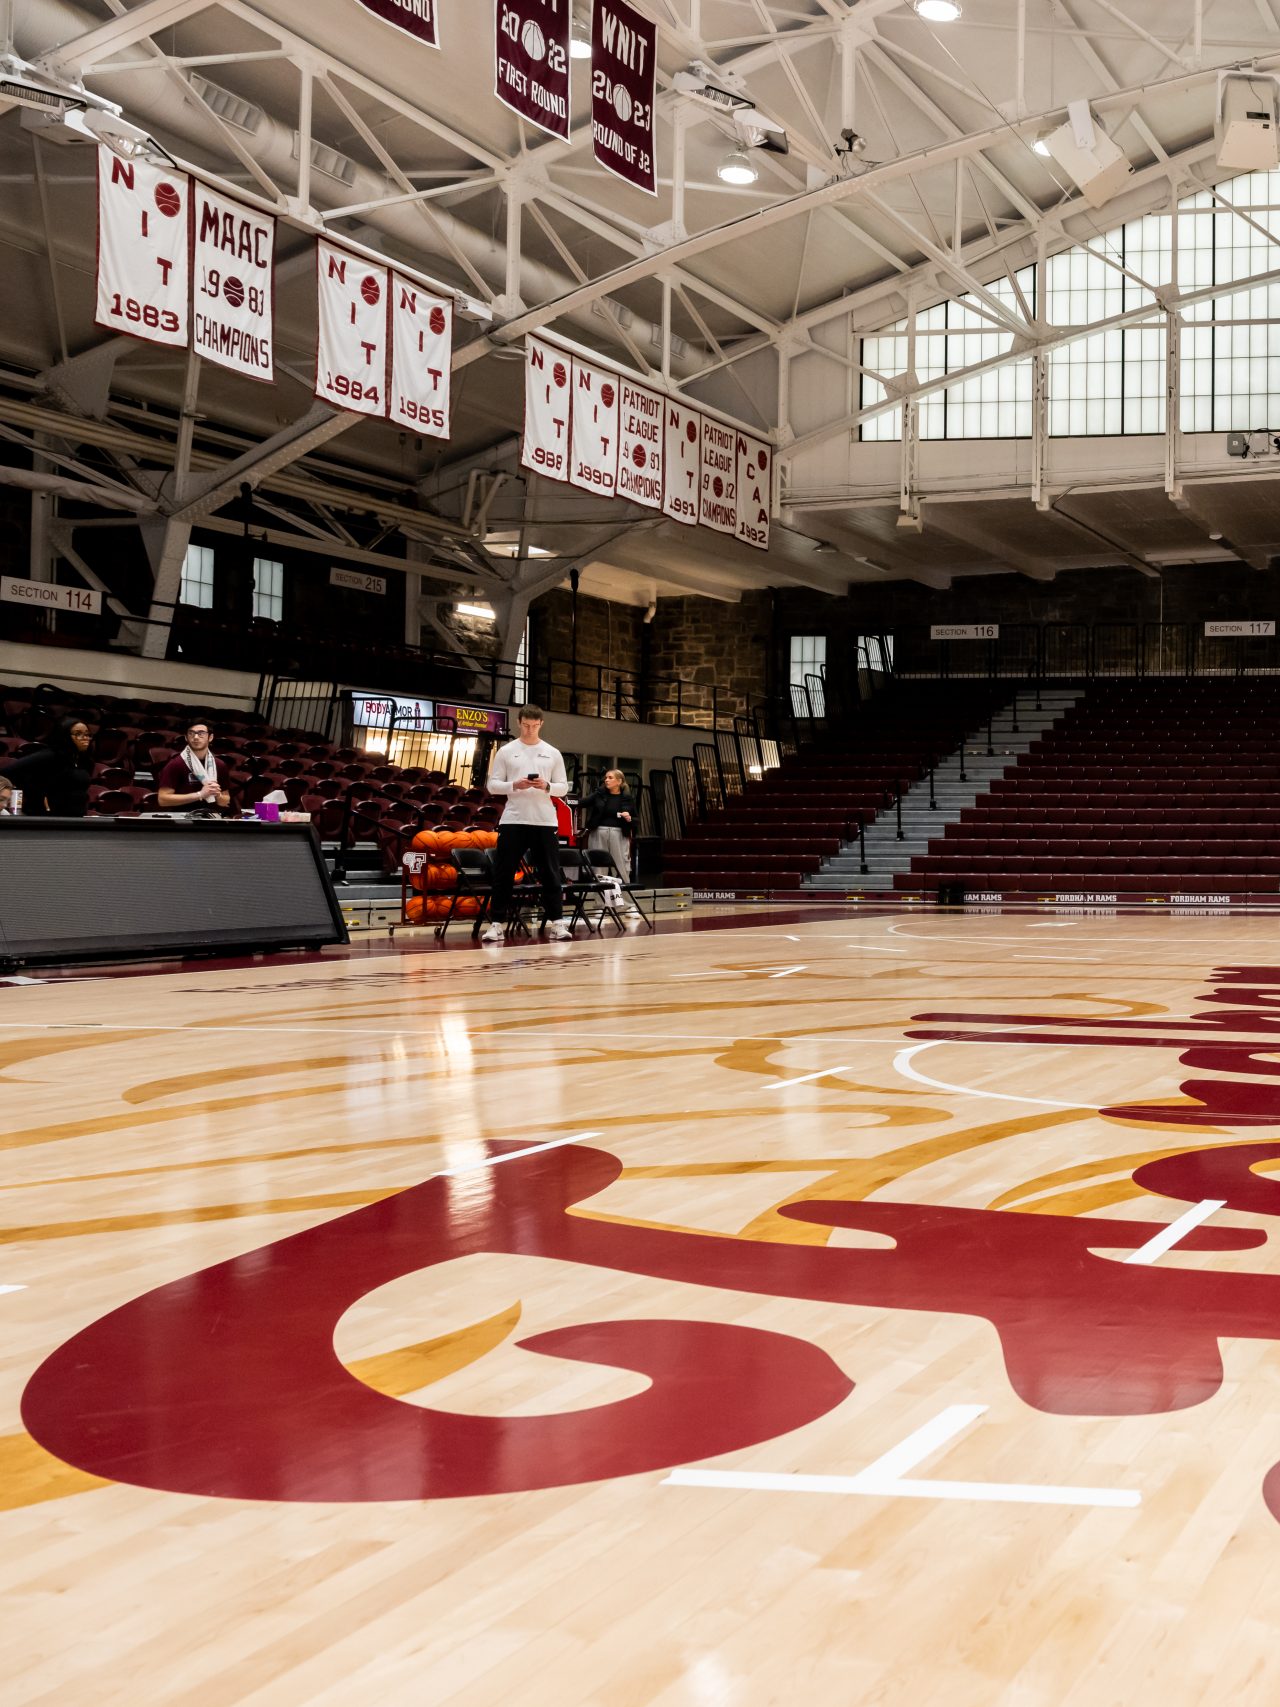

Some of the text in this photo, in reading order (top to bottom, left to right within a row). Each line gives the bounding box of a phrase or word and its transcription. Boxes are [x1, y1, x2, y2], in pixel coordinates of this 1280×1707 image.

[390, 0, 430, 22] UND
[501, 11, 567, 74] 20 22
[601, 6, 648, 76] WNIT
[498, 57, 567, 119] FIRST ROUND
[593, 70, 651, 132] 20 23
[593, 120, 651, 174] ROUND OF 32
[200, 200, 268, 269] MAAC
[200, 265, 264, 317] 19 83
[110, 293, 180, 332] 1983
[195, 313, 269, 368] CHAMPIONS
[326, 371, 379, 404] 1984
[623, 386, 661, 419] PATRIOT
[399, 396, 444, 428] 1985
[624, 412, 659, 443] LEAGUE
[704, 424, 733, 451] PATRIOT
[704, 446, 732, 473] LEAGUE
[577, 462, 614, 488] 1990
[620, 467, 661, 500] CHAMPIONS
[669, 496, 696, 517] 1991
[702, 497, 736, 527] CHAMPIONS
[739, 522, 766, 544] 1992
[10, 584, 92, 610] SECTION 114
[365, 576, 382, 592] 215
[974, 626, 994, 637] 116
[1249, 623, 1270, 634] 117
[365, 701, 413, 717] BODYAMOR
[456, 708, 488, 722] ENZO'S
[1170, 895, 1230, 903] FORDHAM RAMS
